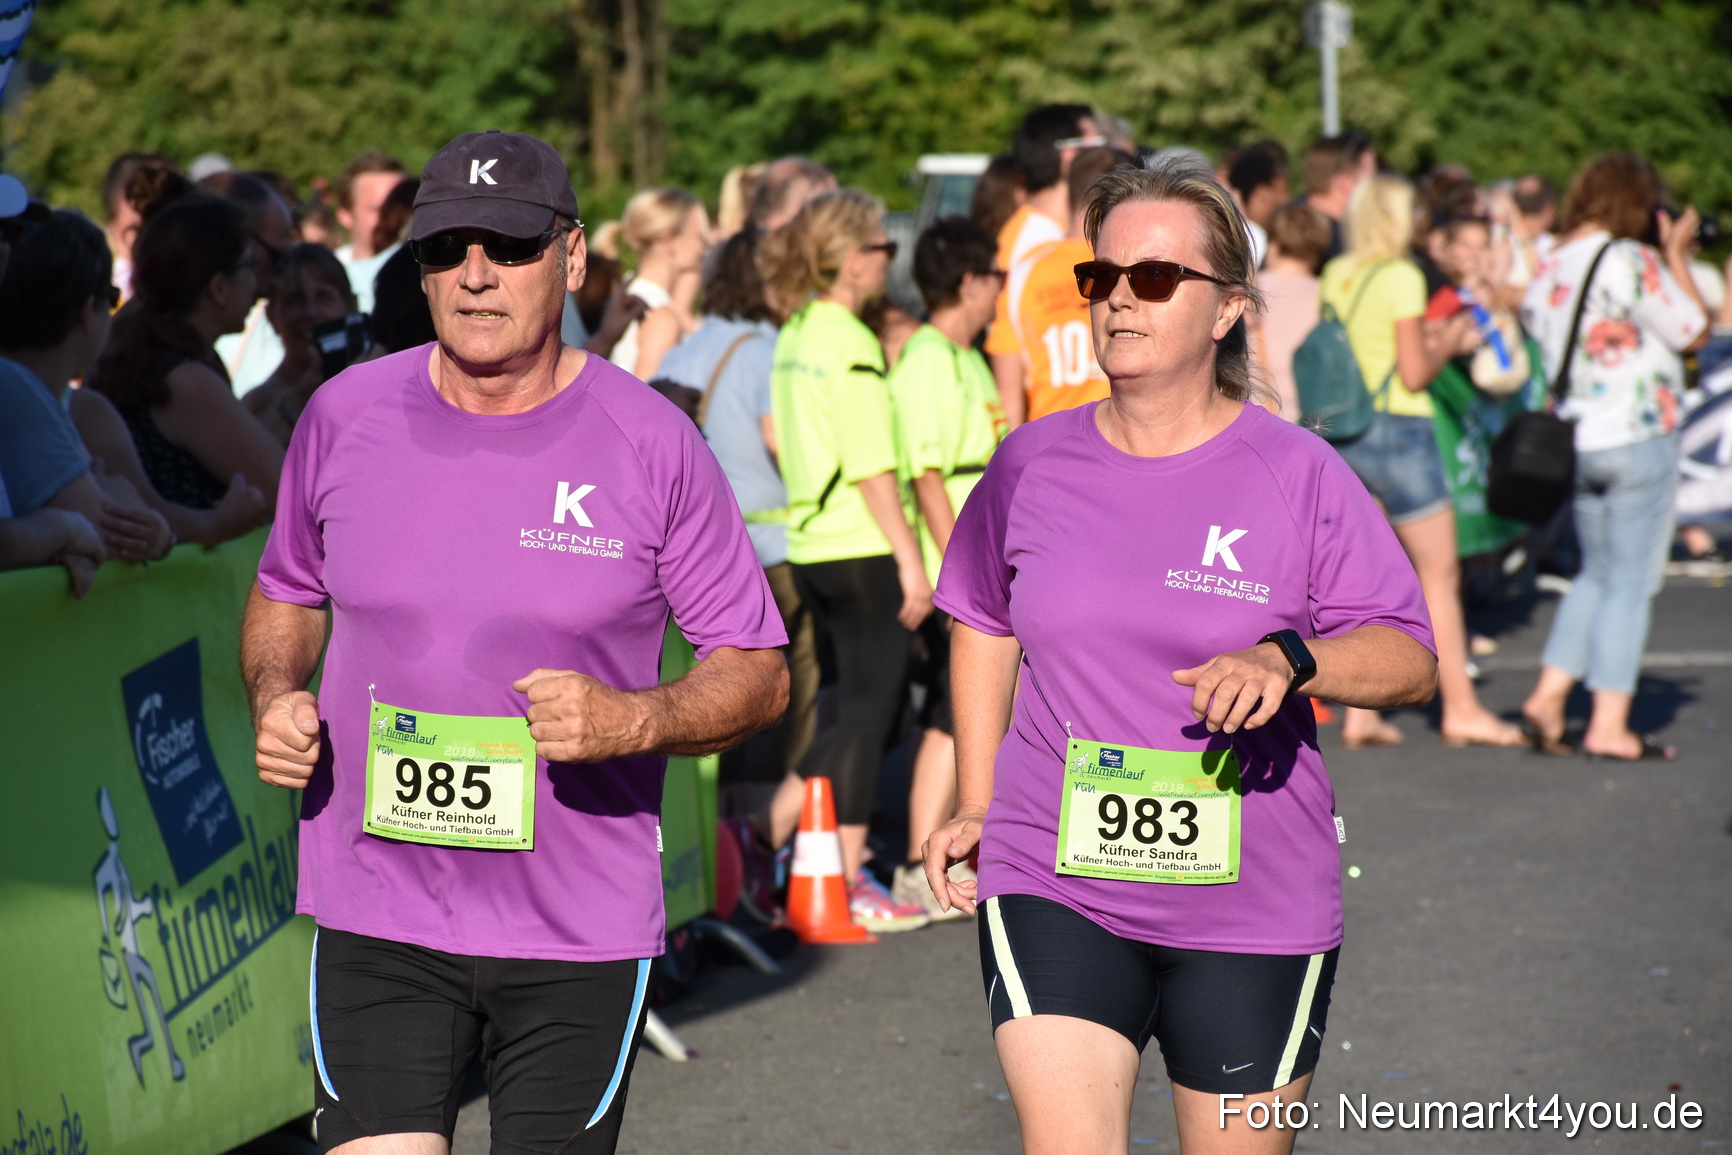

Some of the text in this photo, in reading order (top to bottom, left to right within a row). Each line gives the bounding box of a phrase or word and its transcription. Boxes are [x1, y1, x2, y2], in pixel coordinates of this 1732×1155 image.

[469, 158, 499, 185] K
[553, 480, 597, 529] K
[519, 539, 623, 560] HOCH- UND TIEFBAU GMBH
[520, 528, 624, 551] KÜFNER
[1201, 525, 1249, 573] K
[1164, 579, 1269, 605] HOCH- UND TIEFBAU GMBH
[1167, 568, 1271, 596] KÜFNER
[147, 717, 195, 772] Fischer
[386, 727, 437, 745] firmenlauf
[444, 745, 476, 757] 2018
[1087, 763, 1146, 780] firmenlauf
[395, 757, 492, 811] 985
[1151, 781, 1185, 793] 2018
[376, 814, 514, 836] Küfner Hoch- und Tiefbau GmbH
[391, 804, 496, 825] Küfner Reinhold
[1098, 793, 1199, 847] 983
[1073, 854, 1221, 871] Küfner Hoch- und Tiefbau GmbH
[1099, 843, 1198, 861] Küfner Sandra
